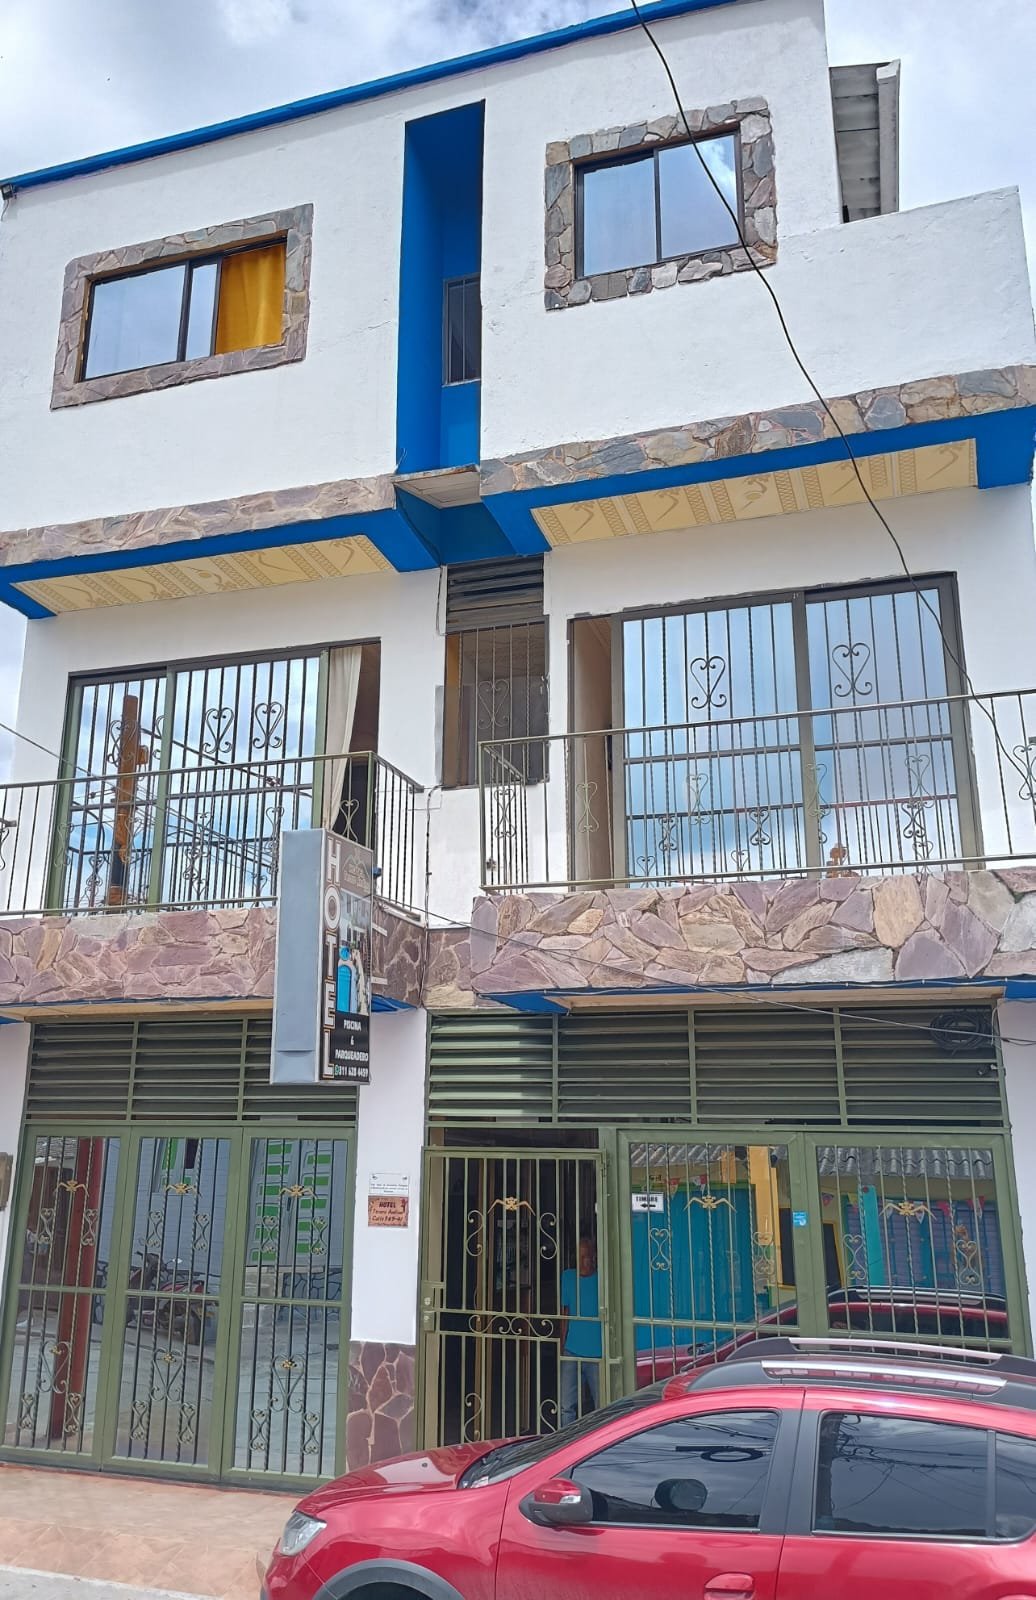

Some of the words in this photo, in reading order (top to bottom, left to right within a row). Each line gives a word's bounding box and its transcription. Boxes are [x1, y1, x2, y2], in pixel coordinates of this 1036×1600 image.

[324, 835, 341, 1079] HOTEL
[343, 1019, 362, 1031] PISCINA
[335, 1048, 369, 1062] PARQUEADERO
[378, 1201, 396, 1209] HOTEL
